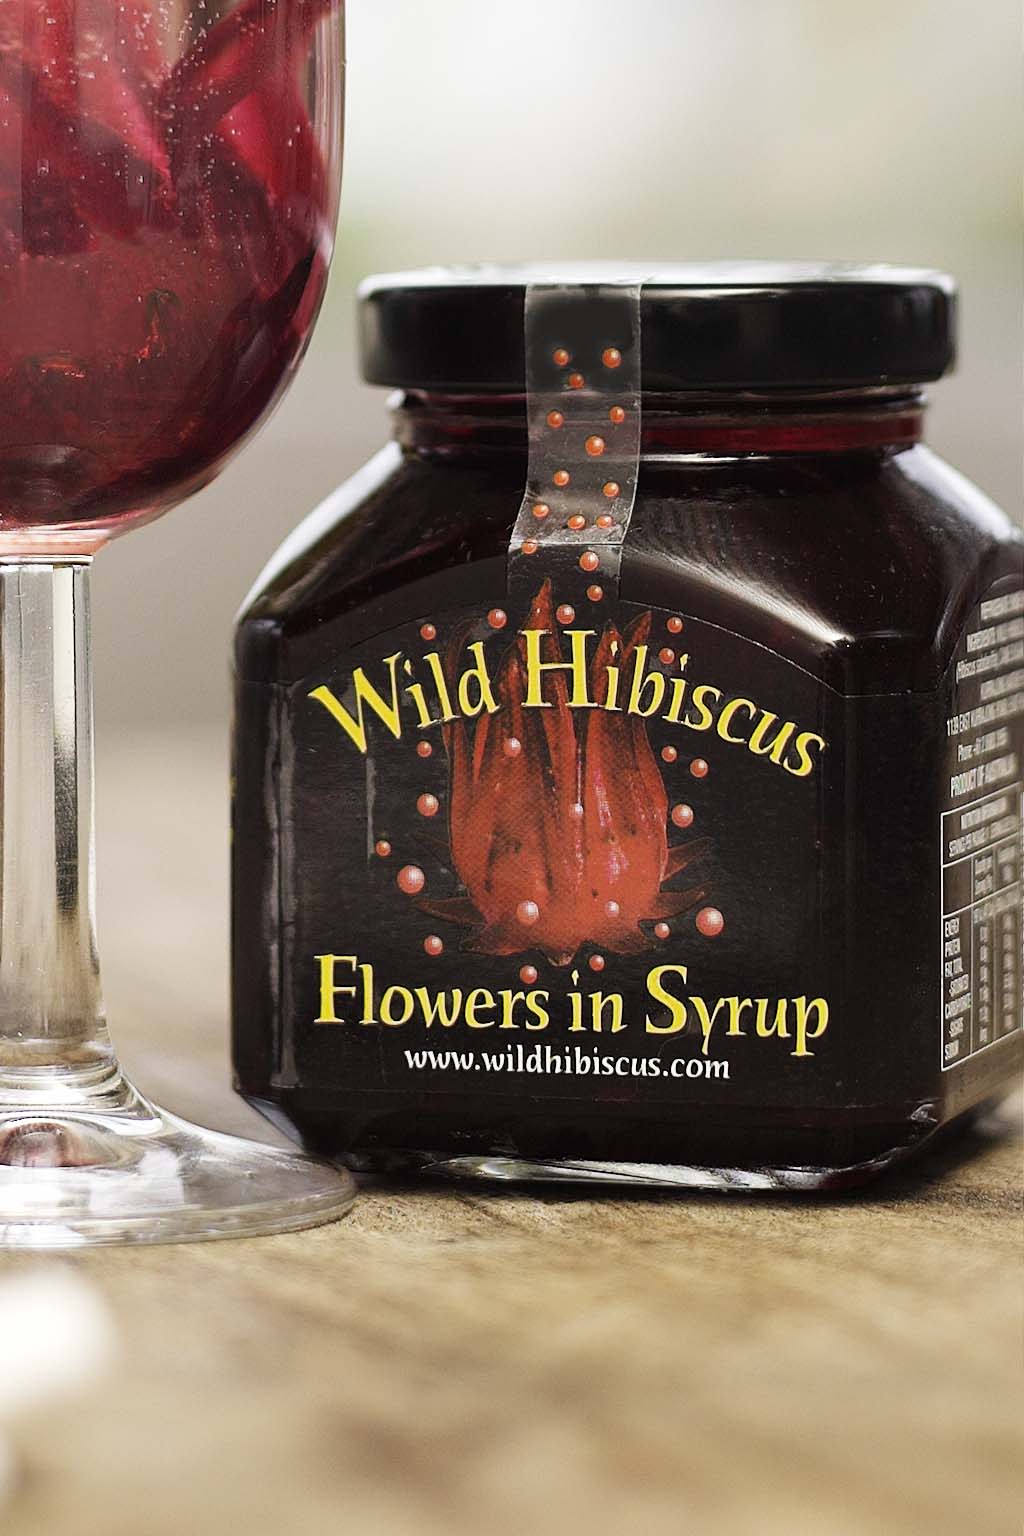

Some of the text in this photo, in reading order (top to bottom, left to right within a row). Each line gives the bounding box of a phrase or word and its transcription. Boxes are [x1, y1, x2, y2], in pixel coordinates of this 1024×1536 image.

[307, 629, 826, 777] Wild Hibiscus
[313, 953, 829, 1056] Flowers in Syrup
[404, 1044, 731, 1080] www.wildhibiscus.com
